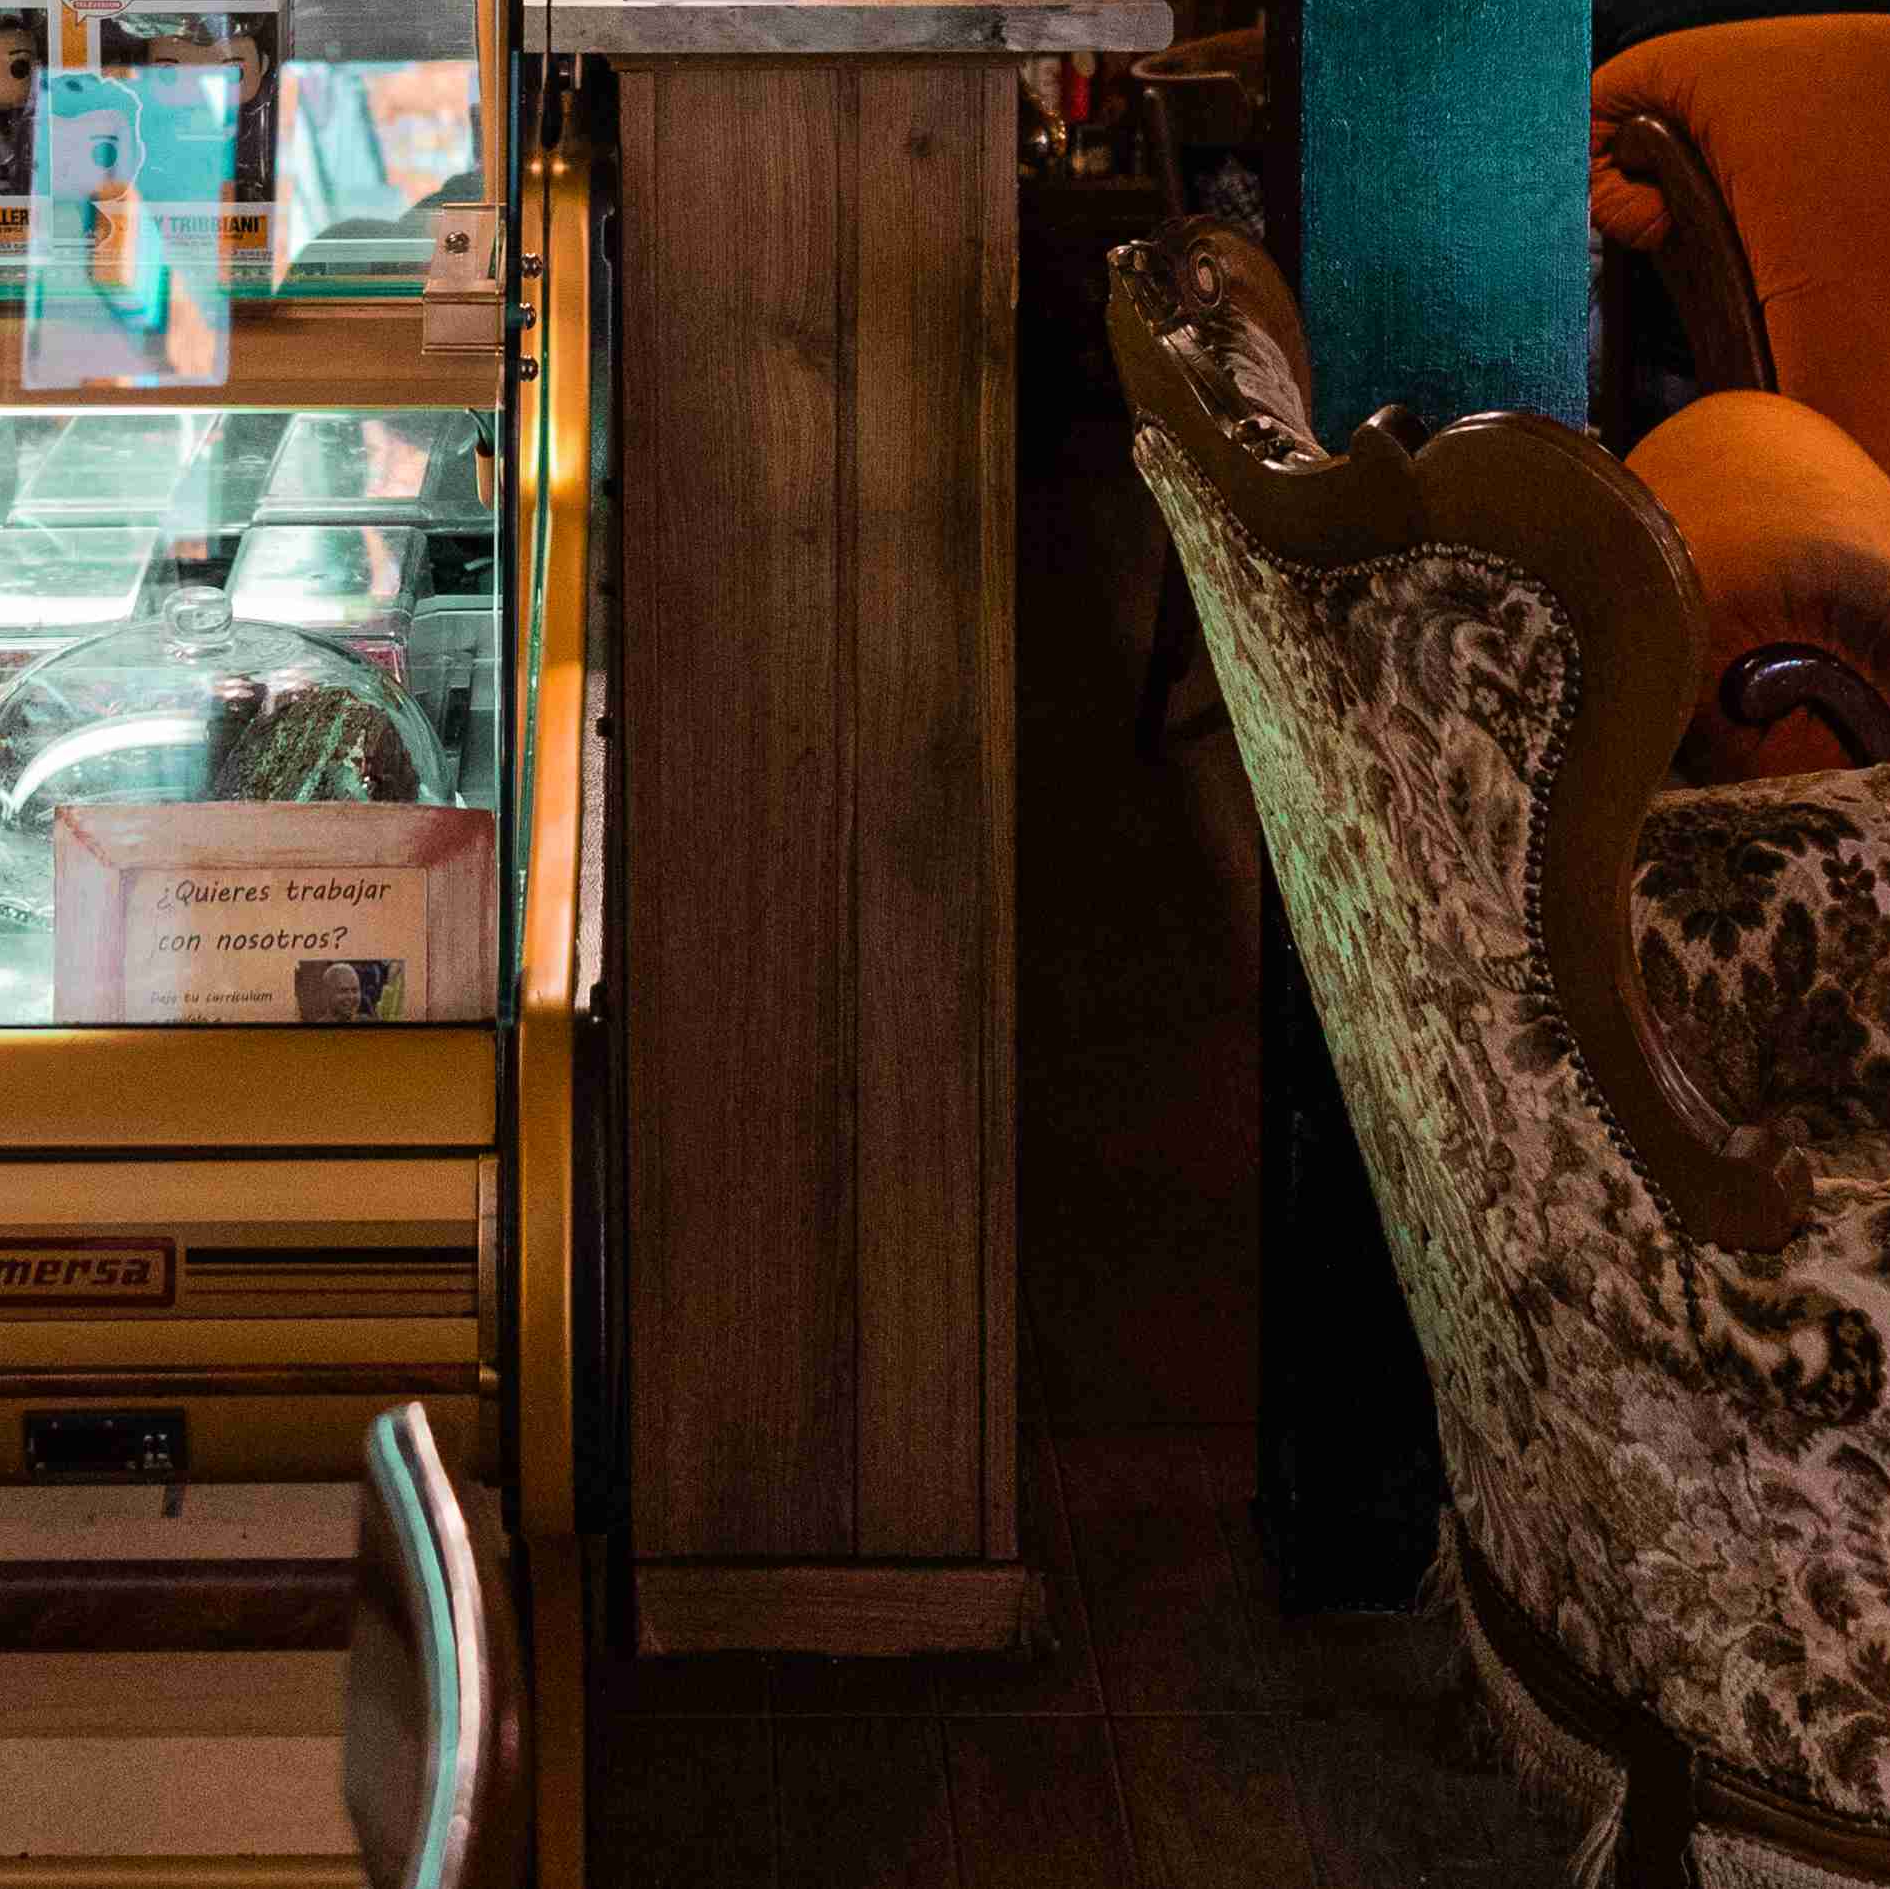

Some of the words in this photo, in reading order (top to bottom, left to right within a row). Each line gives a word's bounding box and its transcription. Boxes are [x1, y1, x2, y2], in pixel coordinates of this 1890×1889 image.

[168, 214, 260, 234] TRIBBIANI
[156, 878, 272, 910] ¿Quieres
[286, 876, 393, 907] trabajar
[157, 931, 203, 953] con
[215, 925, 350, 953] nosotros?
